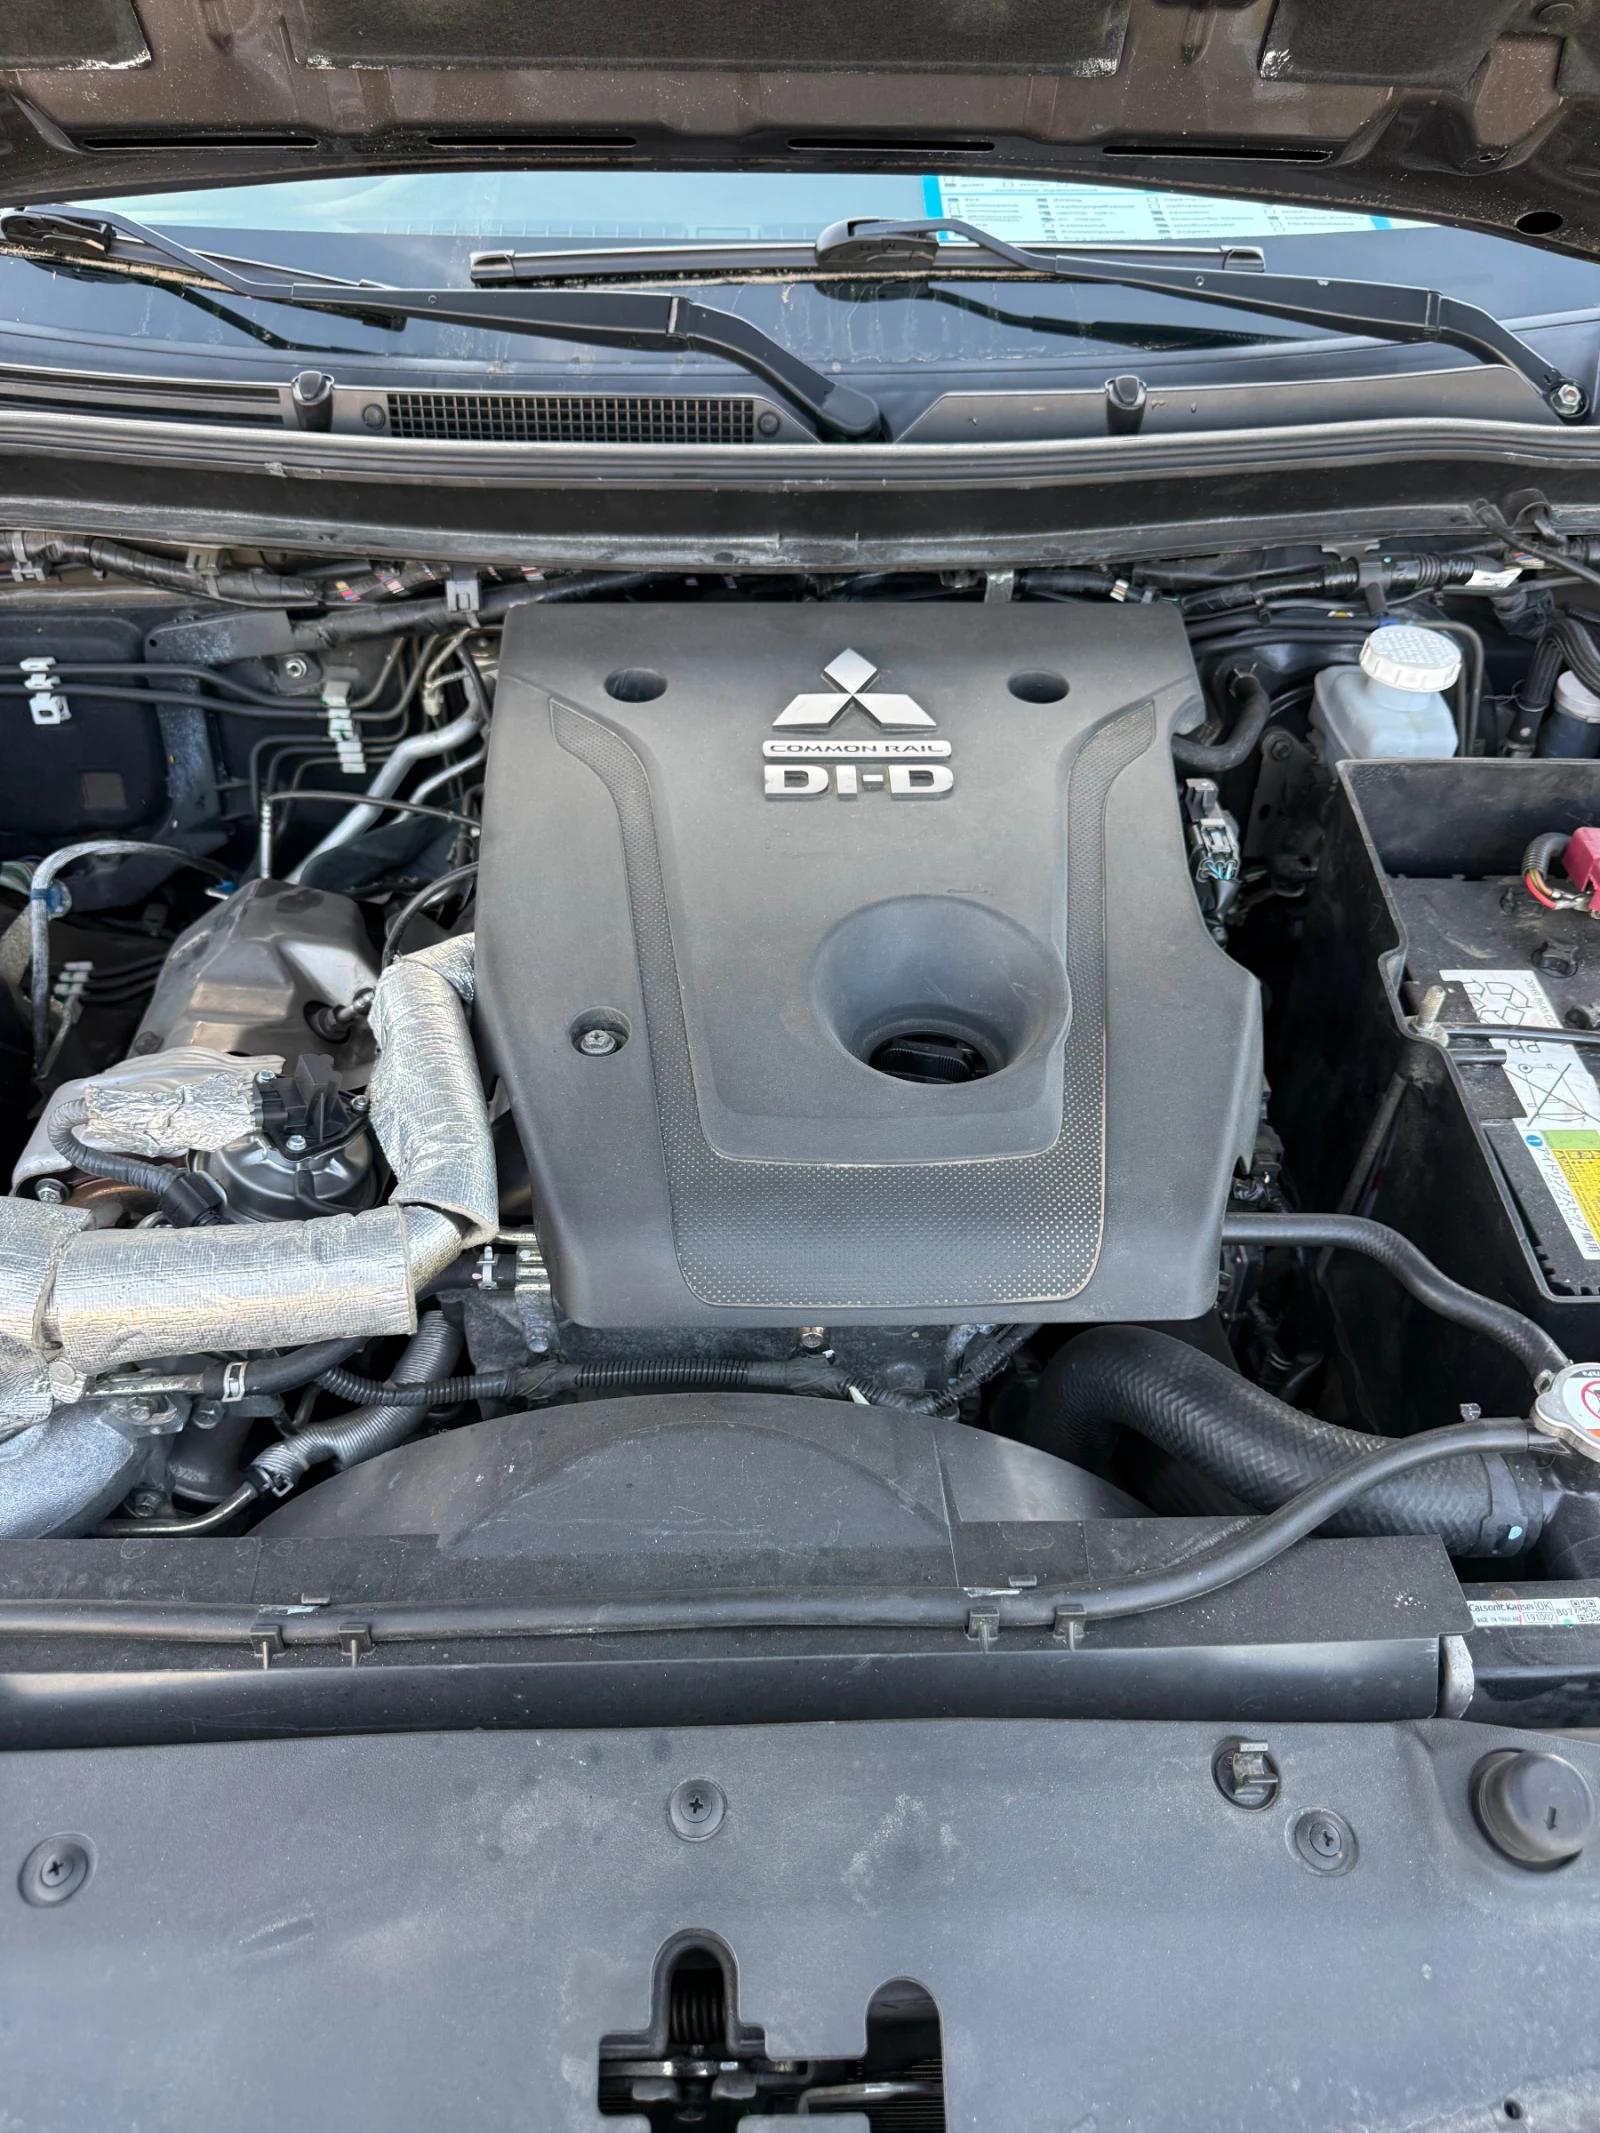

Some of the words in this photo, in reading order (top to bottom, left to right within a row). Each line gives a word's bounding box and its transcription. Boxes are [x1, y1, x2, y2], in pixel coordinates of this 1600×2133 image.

[770, 745, 876, 753] COMMON
[884, 745, 944, 753] RAIL
[764, 765, 954, 799] DI-D
[1536, 1601, 1553, 1611] OK
[1526, 1613, 1555, 1621] 191002
